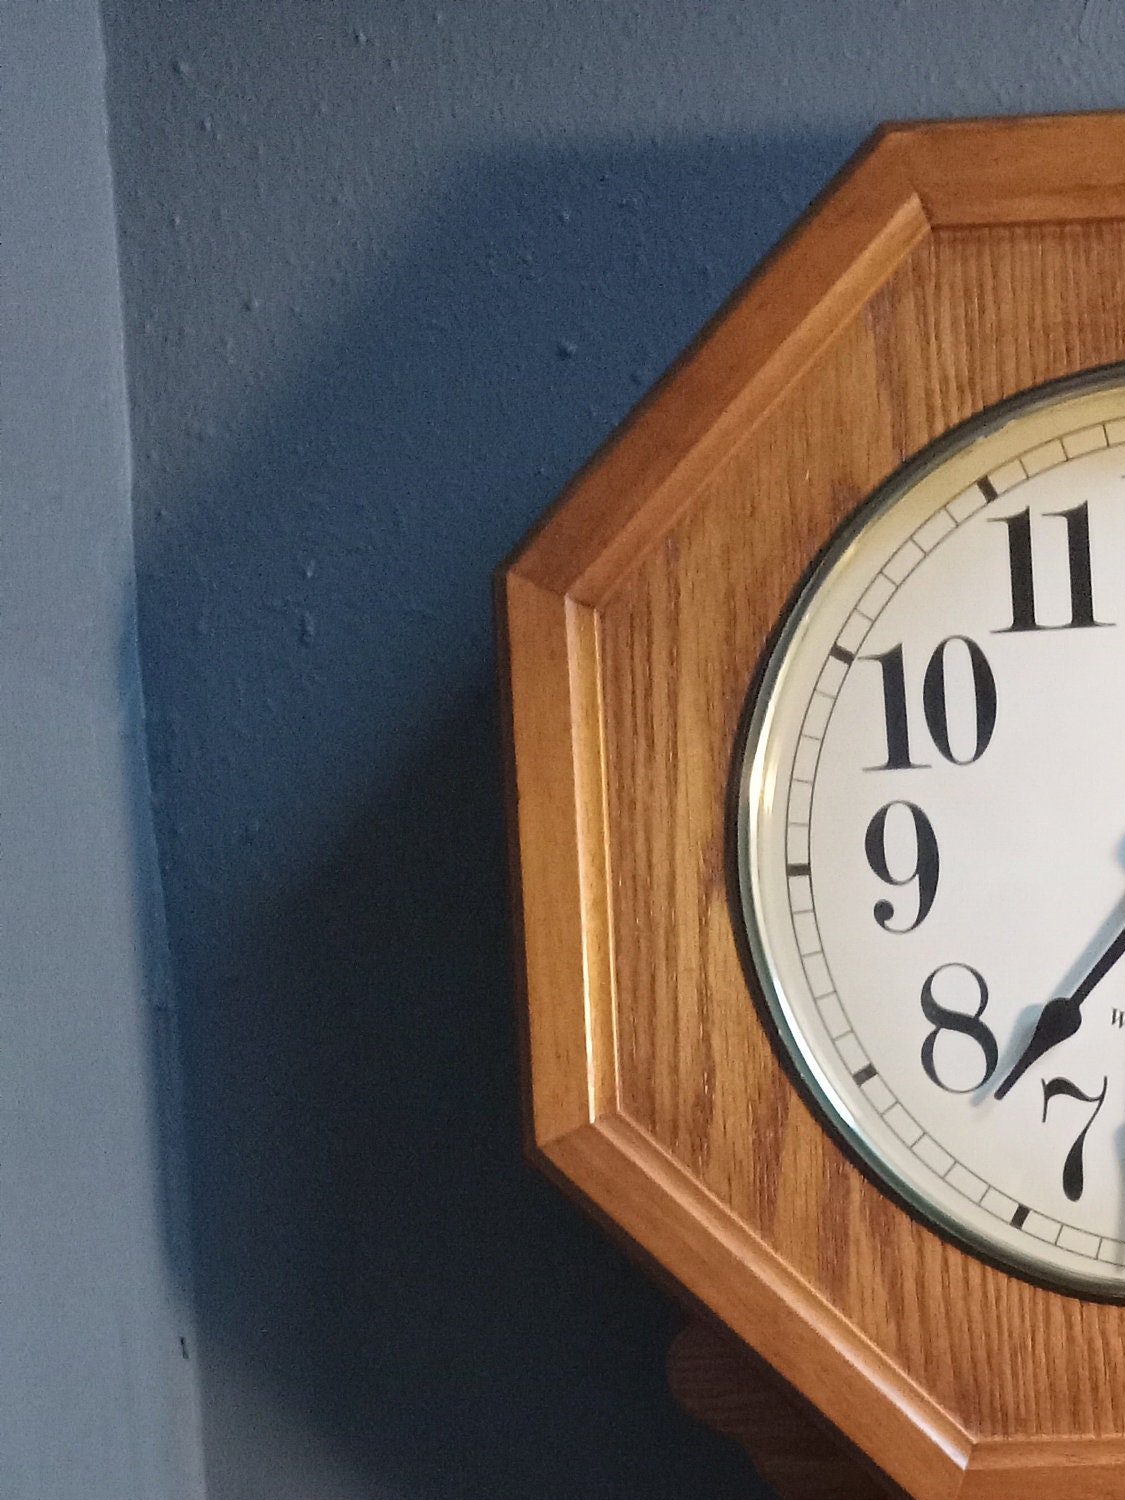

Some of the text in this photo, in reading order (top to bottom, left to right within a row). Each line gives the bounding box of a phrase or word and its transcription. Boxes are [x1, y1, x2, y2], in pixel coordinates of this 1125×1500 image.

[987, 499, 1118, 635] 11
[857, 634, 999, 772] 10
[863, 800, 941, 935] 9
[919, 962, 1000, 1094] 8
[1040, 1075, 1109, 1203] 7
